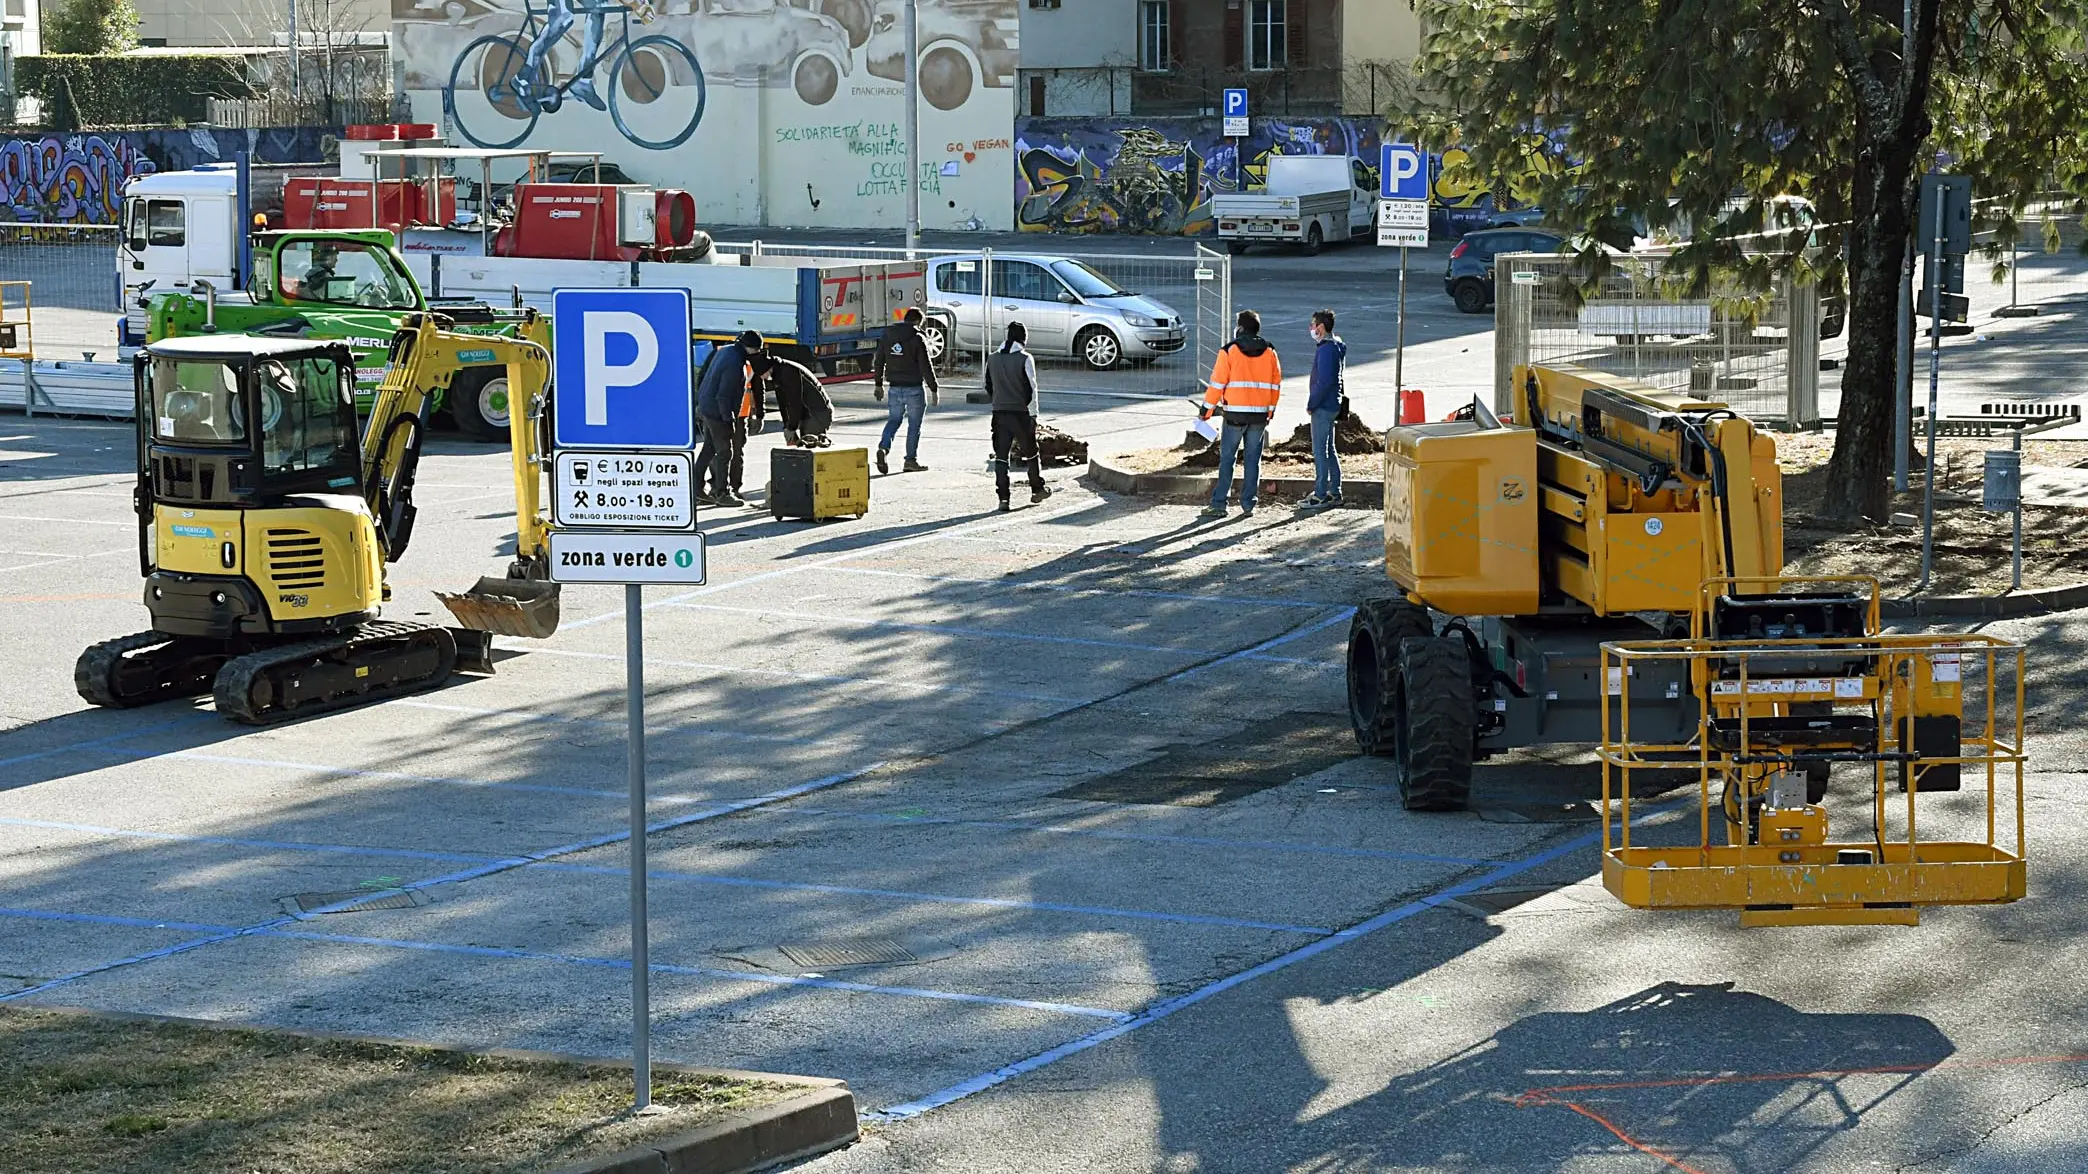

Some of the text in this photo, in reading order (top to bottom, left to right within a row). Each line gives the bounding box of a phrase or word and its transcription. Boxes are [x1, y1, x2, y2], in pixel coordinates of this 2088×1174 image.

[1229, 92, 1243, 113] P
[867, 123, 898, 138] ALLA
[848, 139, 907, 156] MAGNIFIC
[946, 139, 1010, 153] GO VEGAN
[871, 161, 938, 180] OCCUTA
[1390, 149, 1419, 193] P
[857, 180, 941, 196] LOTTA FCIA
[1399, 233, 1417, 241] verde
[346, 336, 391, 348] MERL
[583, 311, 659, 426] P
[597, 459, 609, 473] €
[597, 478, 679, 488] negli spazi segnati
[655, 514, 680, 522] TICKET
[561, 551, 606, 566] zona
[613, 546, 668, 567] verde
